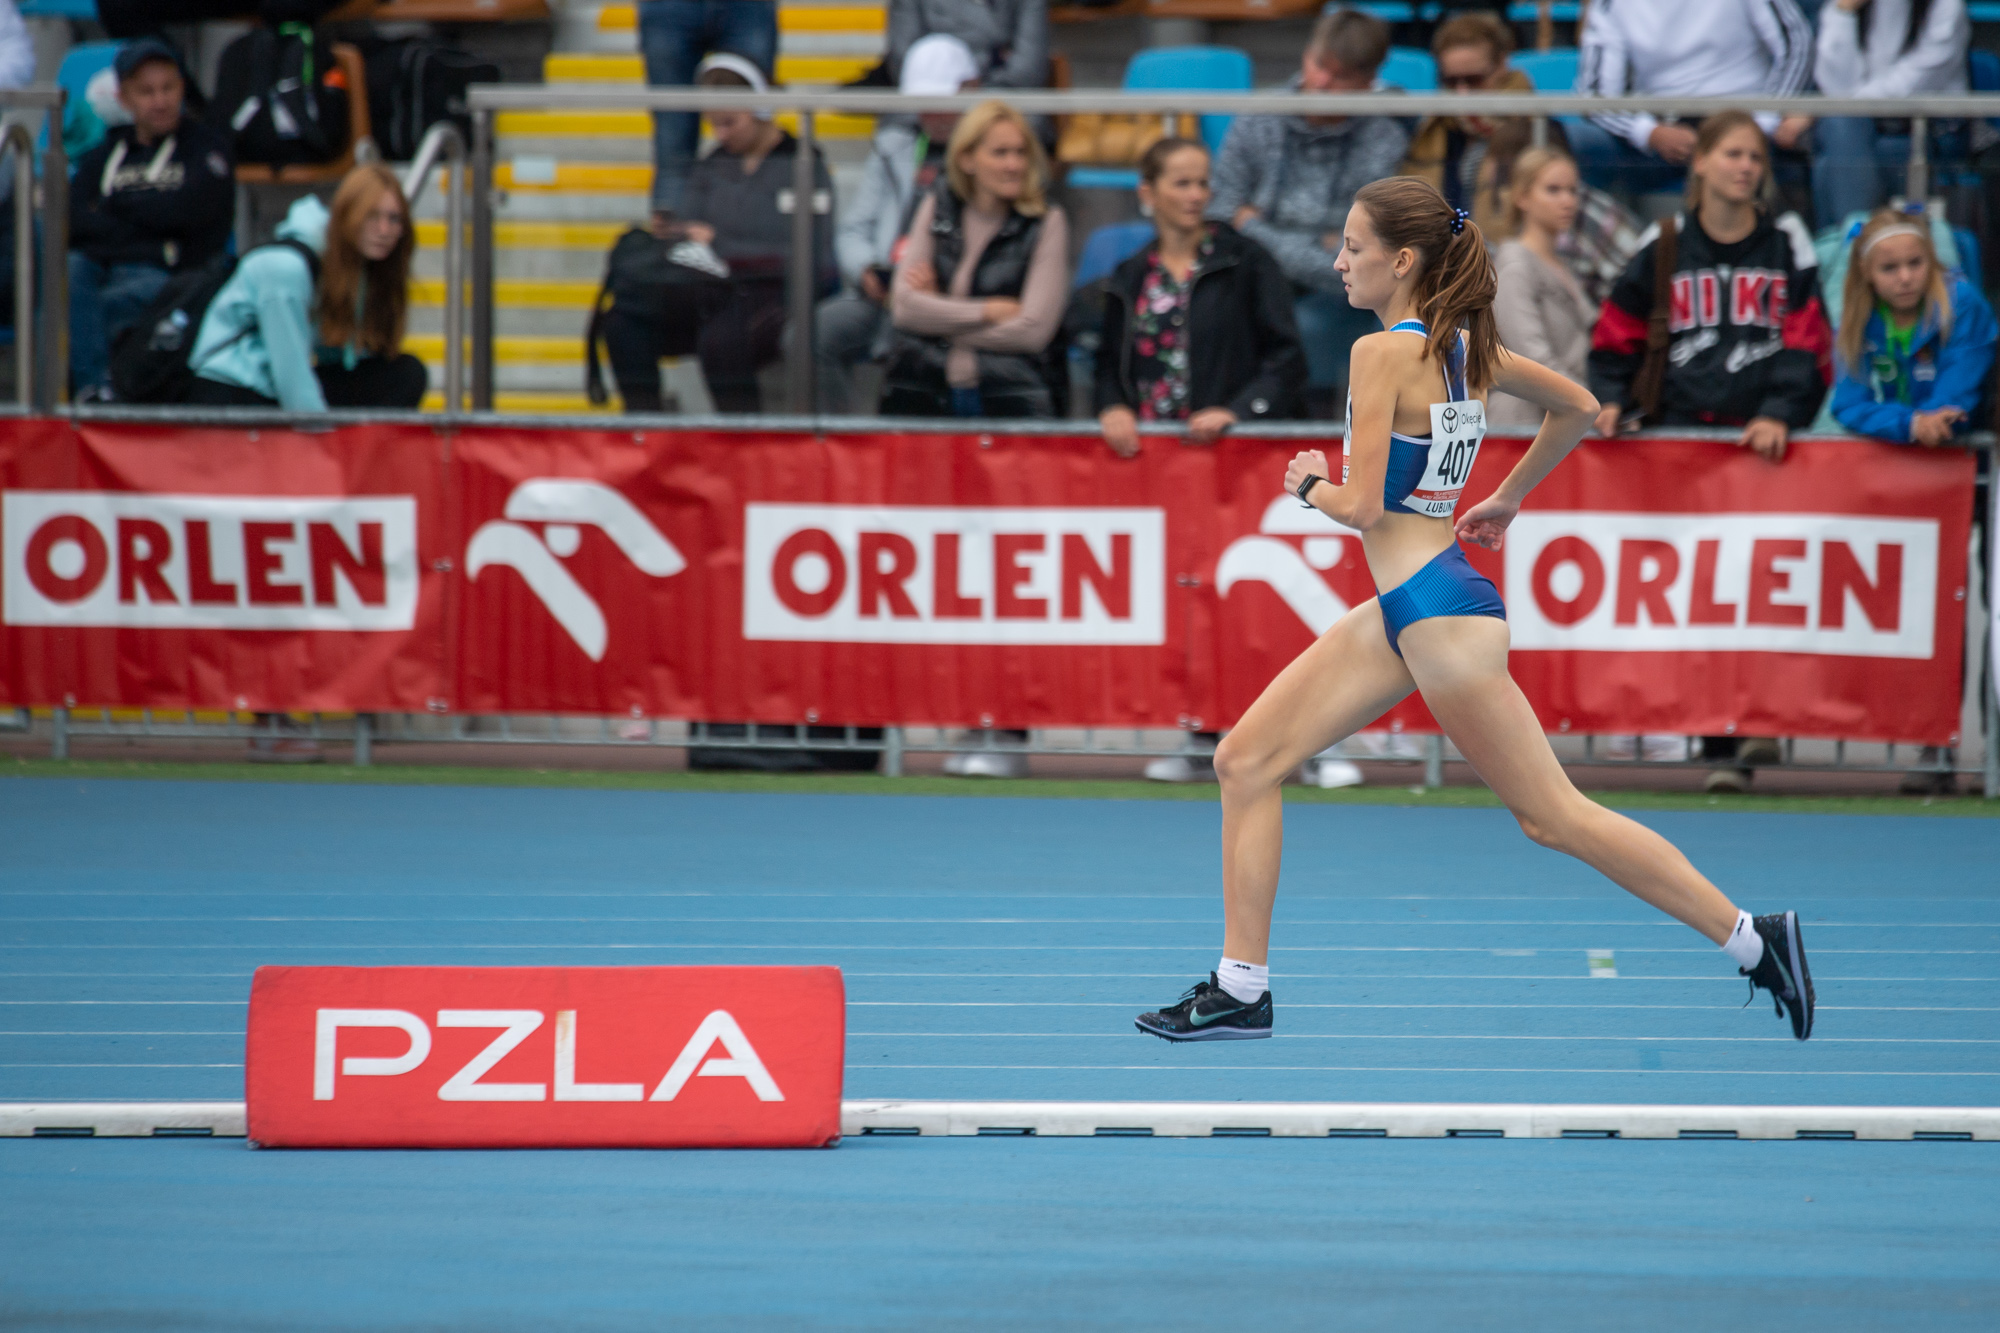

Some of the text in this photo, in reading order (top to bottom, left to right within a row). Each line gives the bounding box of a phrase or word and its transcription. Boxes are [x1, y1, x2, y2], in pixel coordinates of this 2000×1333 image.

[1669, 267, 1788, 333] NIKE
[1437, 437, 1477, 487] 407
[24, 513, 389, 608] ORLEN
[771, 527, 1133, 621] ORLEN
[1531, 535, 1904, 633] ORLEN
[313, 1008, 786, 1102] PZLA
